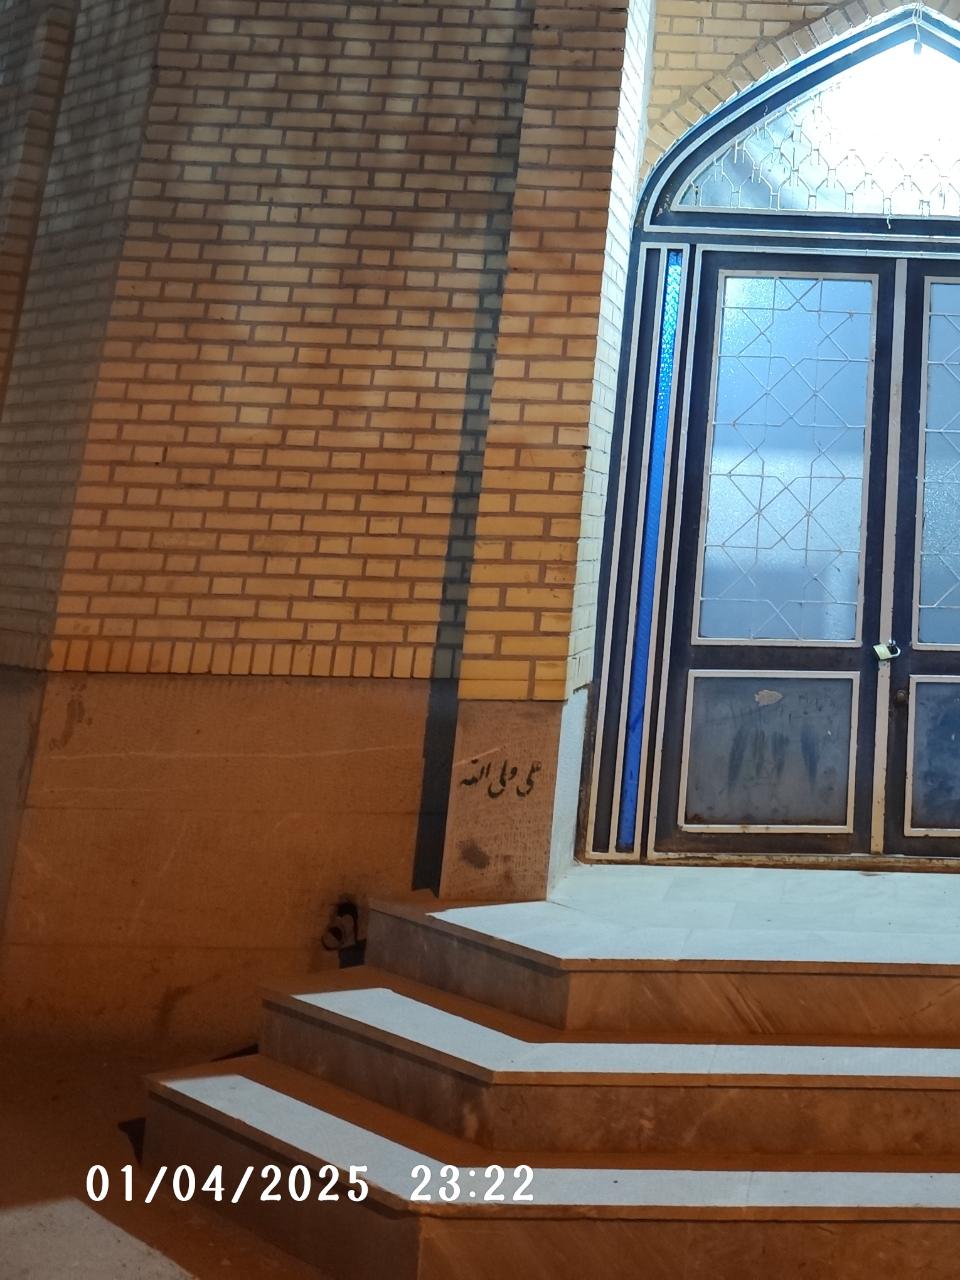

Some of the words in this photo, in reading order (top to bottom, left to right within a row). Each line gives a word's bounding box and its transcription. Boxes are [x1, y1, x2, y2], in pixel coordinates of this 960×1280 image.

[459, 758, 492, 787] الله
[487, 759, 518, 798] ولی
[516, 760, 542, 797] علی
